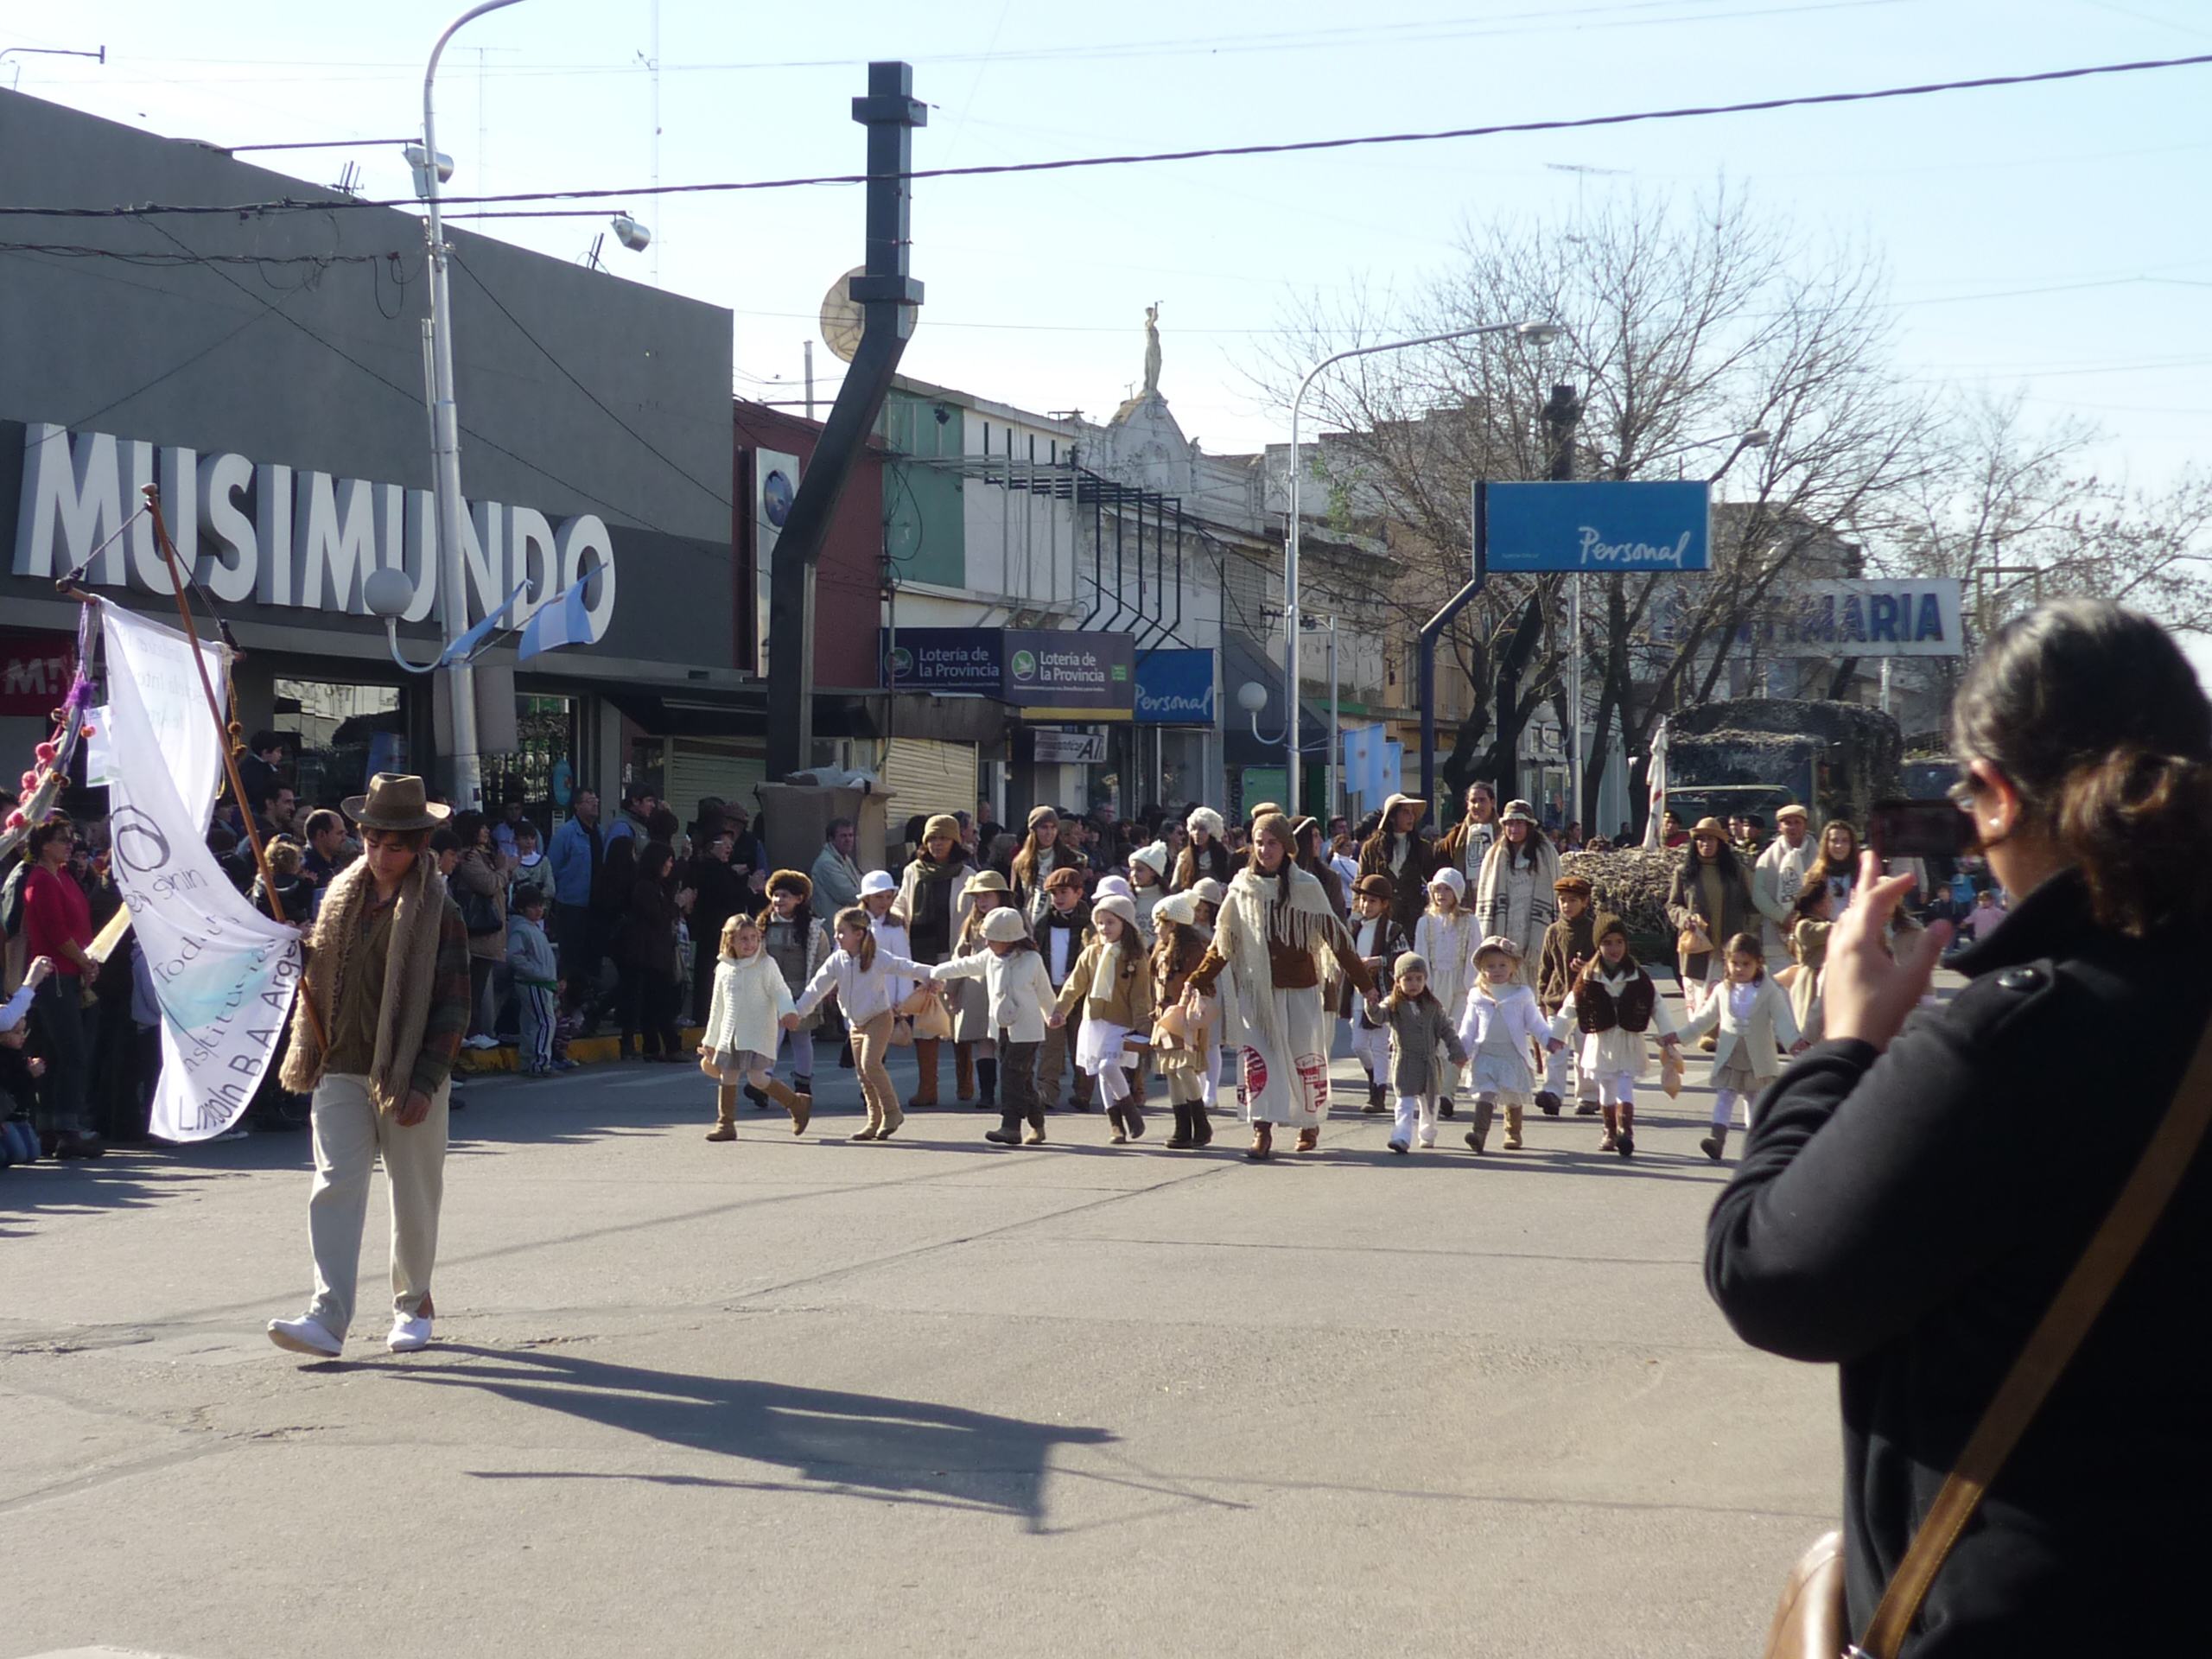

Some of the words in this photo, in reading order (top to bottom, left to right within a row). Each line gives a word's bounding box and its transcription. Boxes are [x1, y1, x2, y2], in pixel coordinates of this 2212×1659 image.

[11, 421, 617, 645] MUSIMUNDO
[1578, 525, 1691, 569] Personal
[918, 646, 969, 662] Lotería
[970, 645, 989, 662] de
[1039, 650, 1080, 666] Lotería
[1081, 651, 1097, 667] de
[918, 662, 933, 677] la
[935, 662, 1001, 678] Provincia
[1039, 665, 1052, 682] la
[1053, 666, 1106, 683] Provincia
[1134, 682, 1213, 716] Personal
